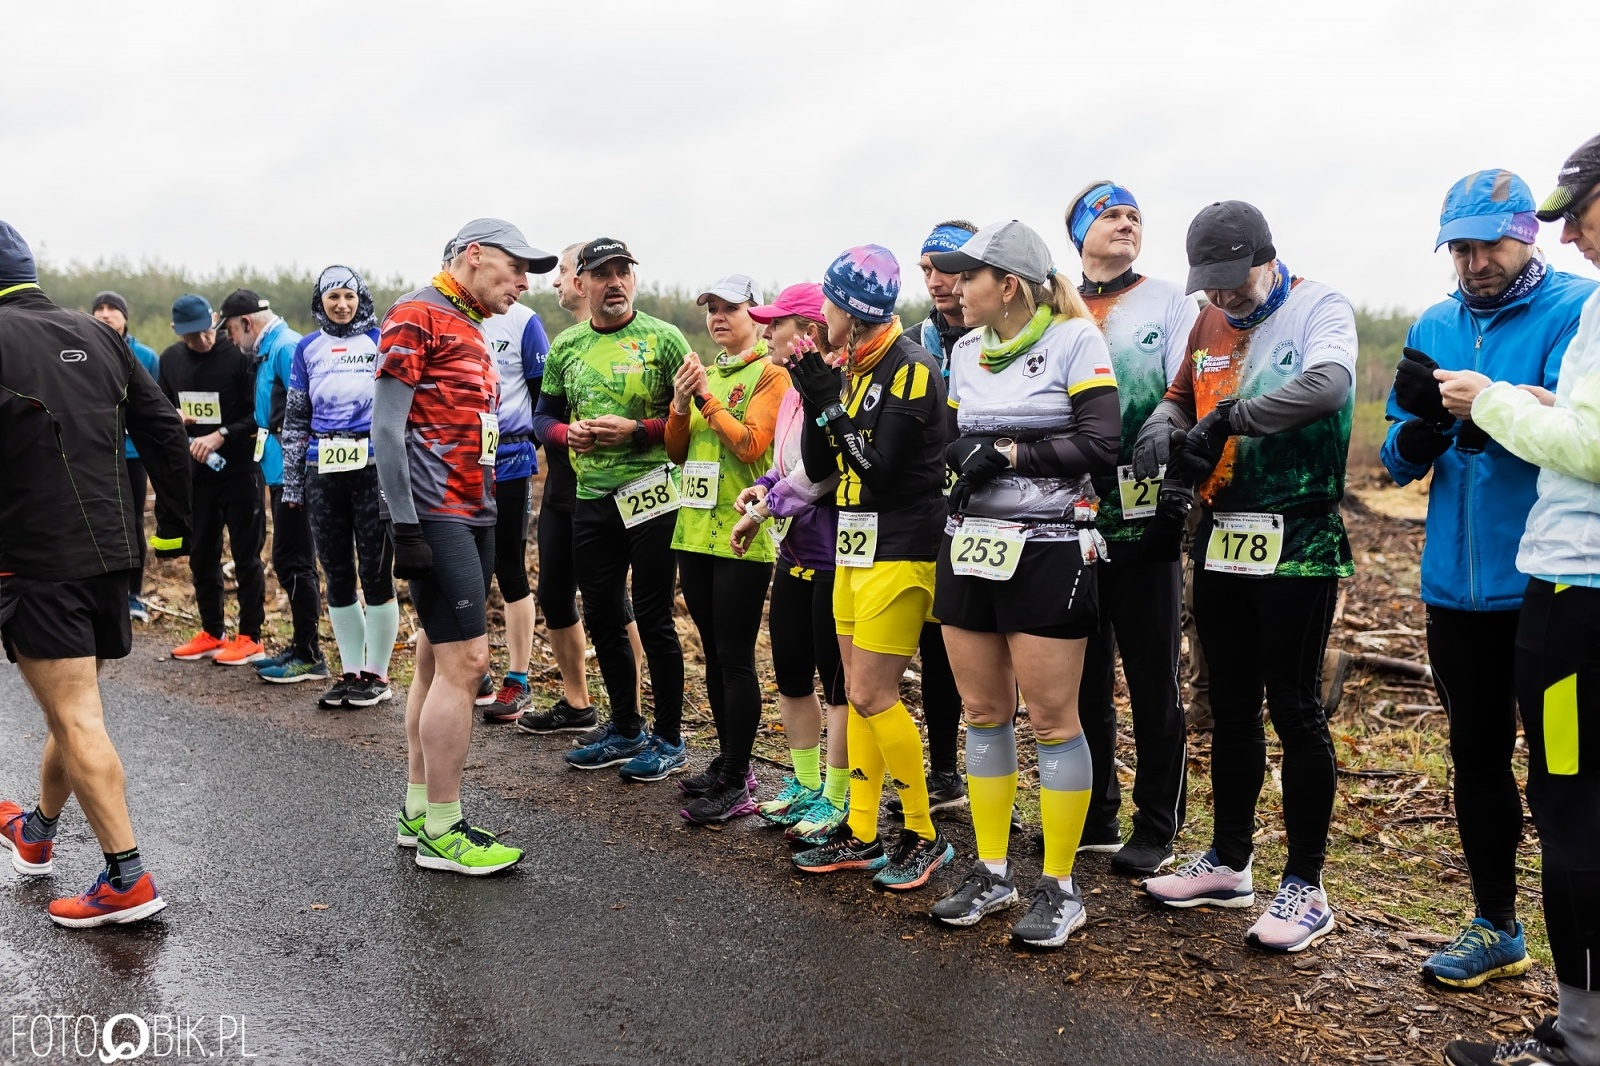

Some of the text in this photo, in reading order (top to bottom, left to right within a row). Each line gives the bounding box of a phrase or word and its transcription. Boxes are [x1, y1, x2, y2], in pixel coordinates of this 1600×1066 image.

[187, 403, 214, 417] 165
[325, 448, 360, 464] 204
[843, 432, 873, 470] Rogelli
[627, 485, 670, 517] 258
[685, 477, 709, 499] 155
[838, 531, 867, 556] 32
[956, 537, 1008, 567] 253
[1222, 532, 1268, 562] 178
